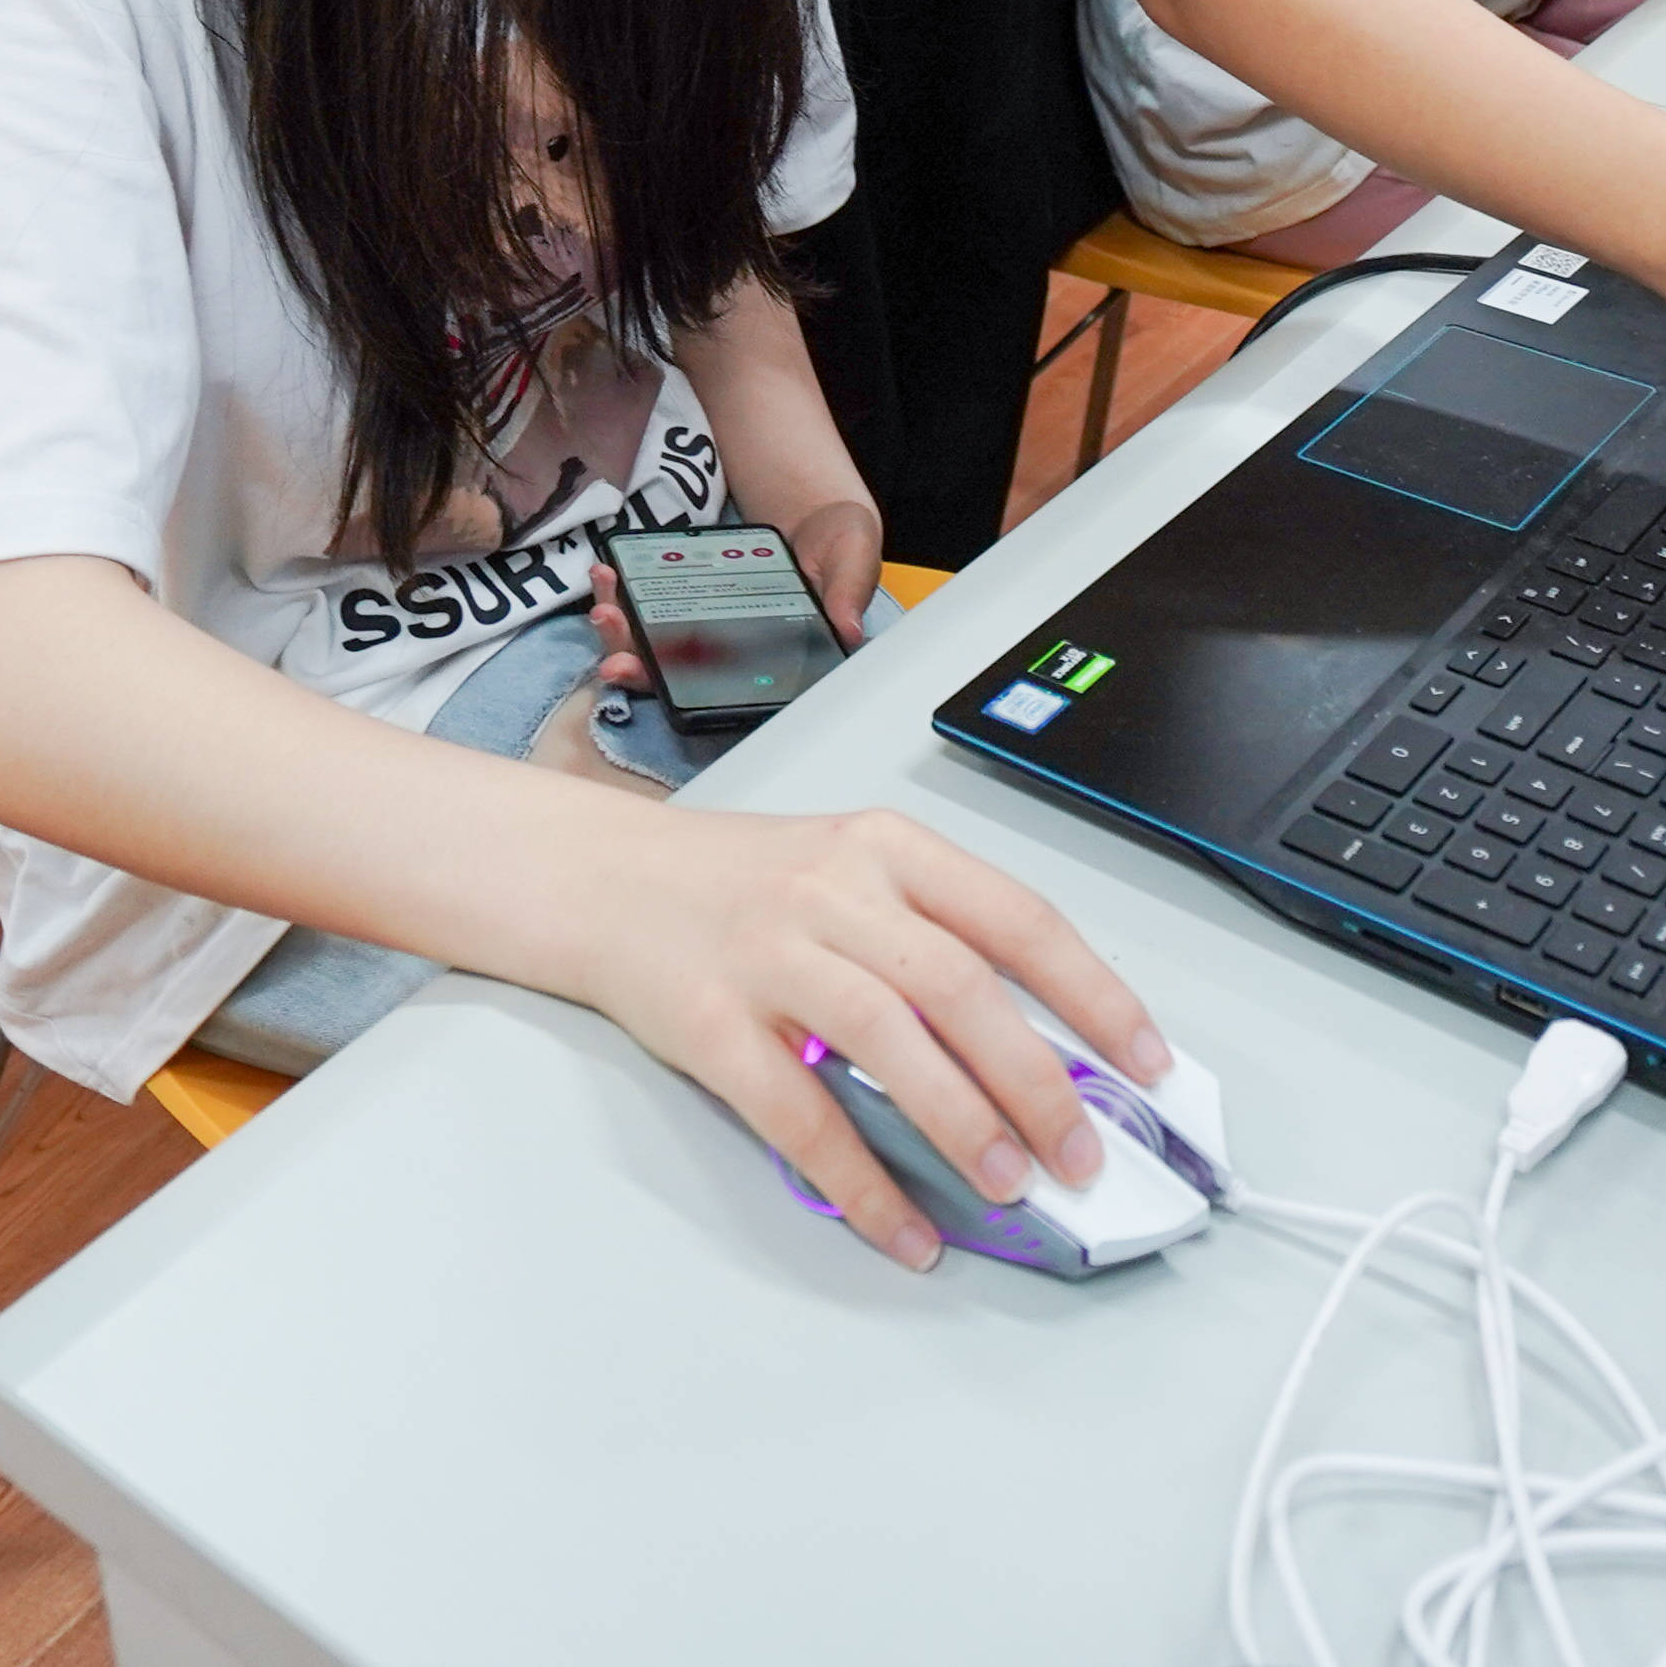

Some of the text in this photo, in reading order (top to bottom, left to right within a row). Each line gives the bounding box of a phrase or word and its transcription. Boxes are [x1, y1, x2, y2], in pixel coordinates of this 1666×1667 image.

[1392, 748, 1408, 757] 0
[1471, 758, 1487, 766] 1
[1532, 781, 1546, 790] 4
[1440, 788, 1458, 799] 2
[1593, 805, 1612, 817] 7
[1501, 813, 1521, 825] 5
[1410, 823, 1427, 834] 3
[1564, 839, 1583, 850] 8
[1472, 849, 1489, 859] 6
[1536, 876, 1554, 886] 9
